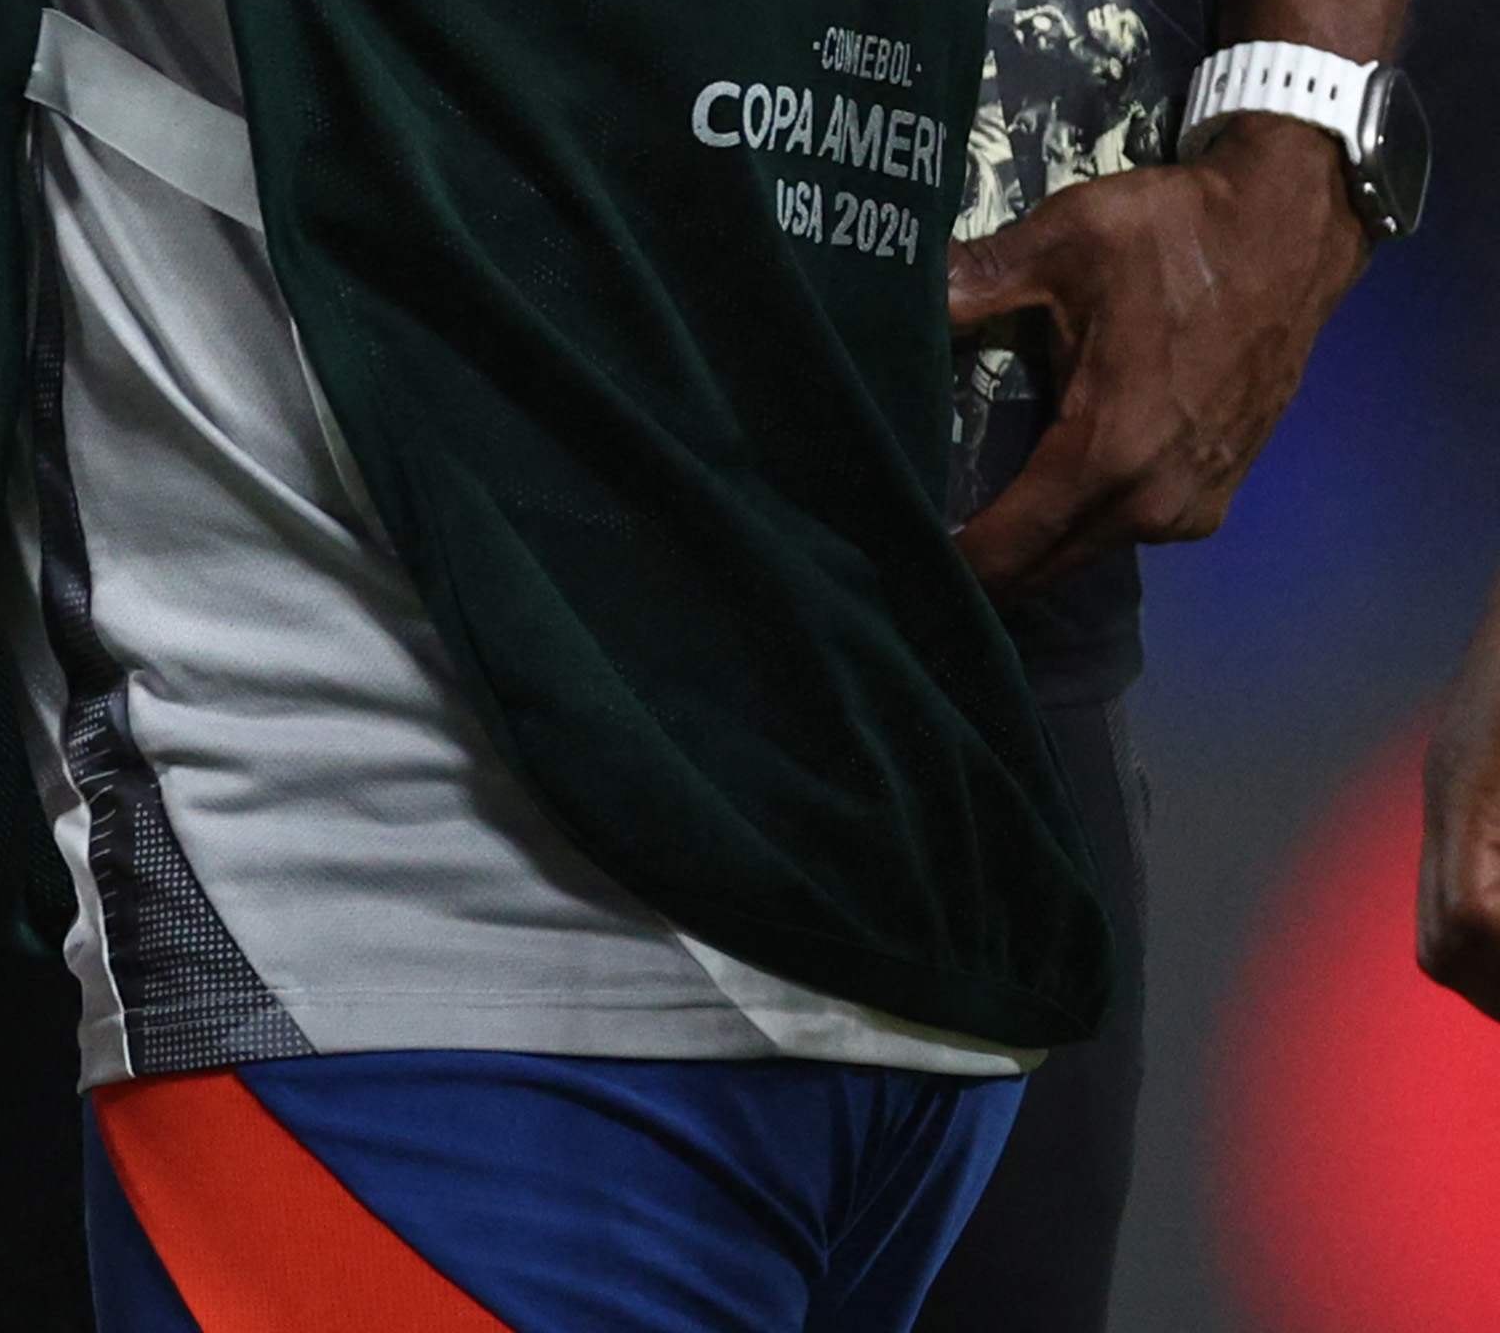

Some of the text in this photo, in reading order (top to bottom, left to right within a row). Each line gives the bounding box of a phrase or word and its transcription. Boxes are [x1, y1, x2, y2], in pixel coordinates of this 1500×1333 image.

[691, 80, 947, 188] COPA AMERI
[776, 178, 920, 264] USA 2024
